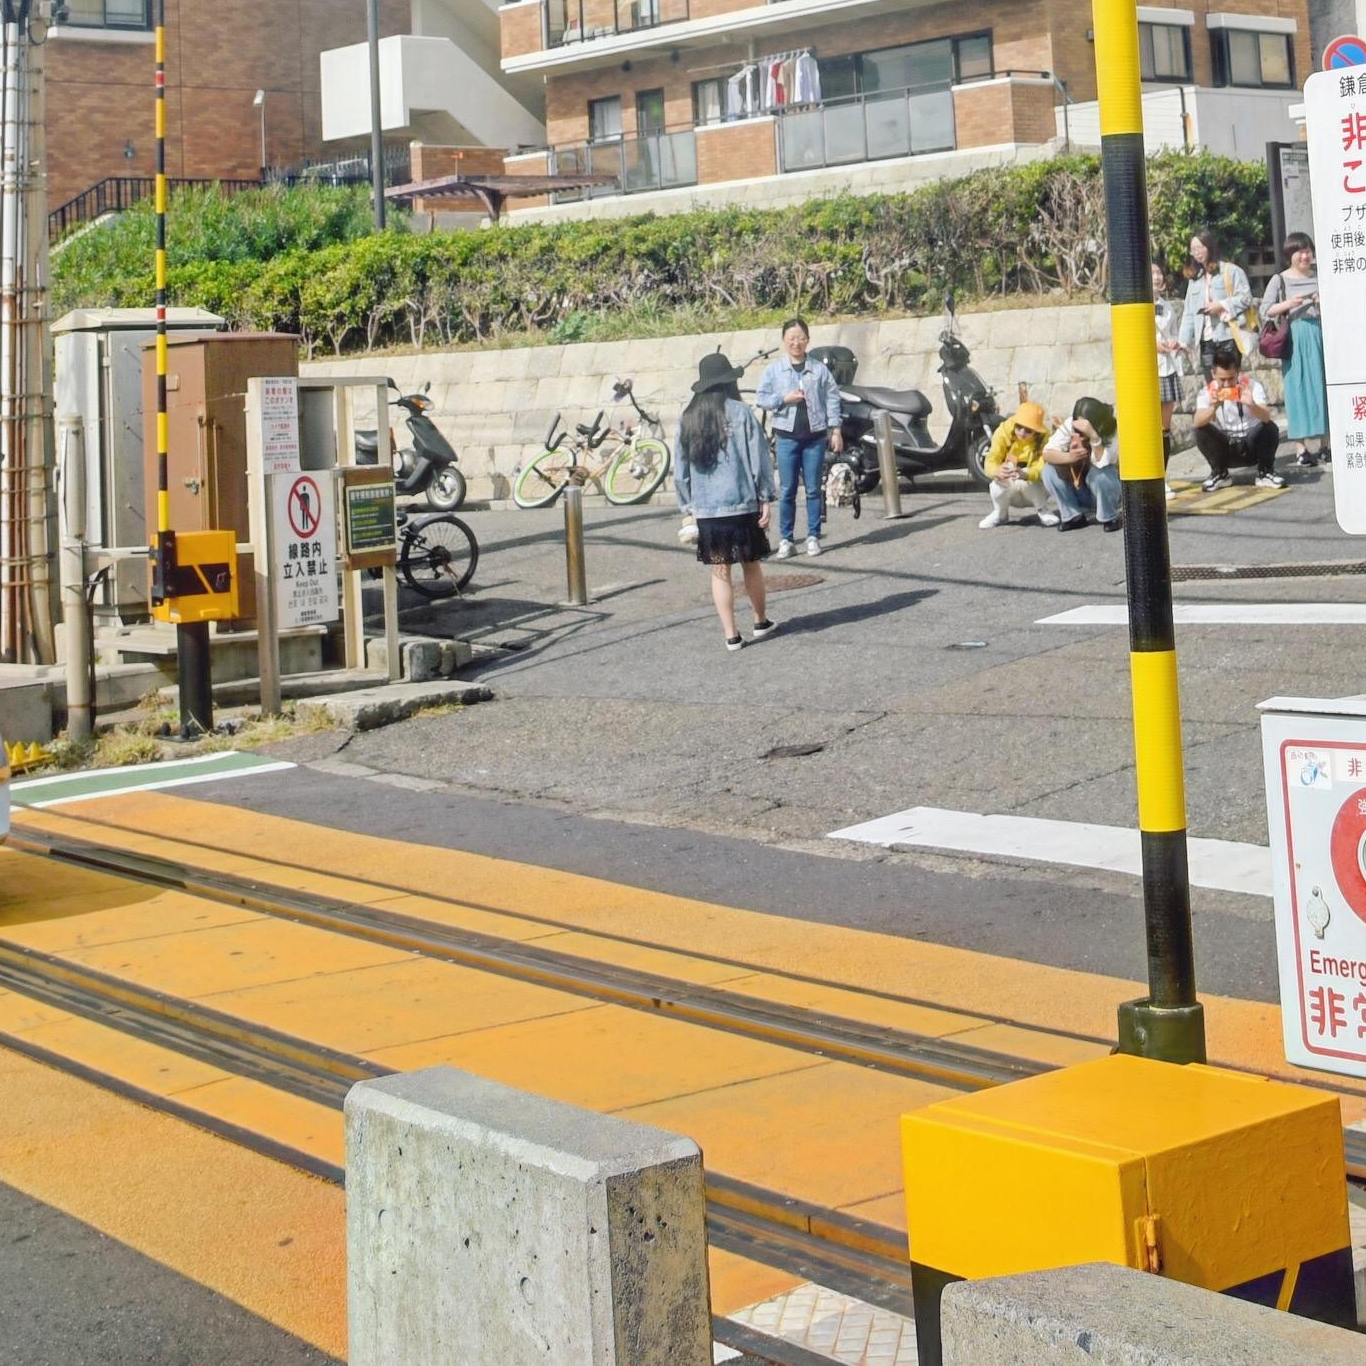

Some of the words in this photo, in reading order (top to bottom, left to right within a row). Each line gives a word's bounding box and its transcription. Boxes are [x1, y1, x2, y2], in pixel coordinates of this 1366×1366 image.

[289, 540, 322, 560] 線路内
[283, 558, 328, 579] 立入禁止
